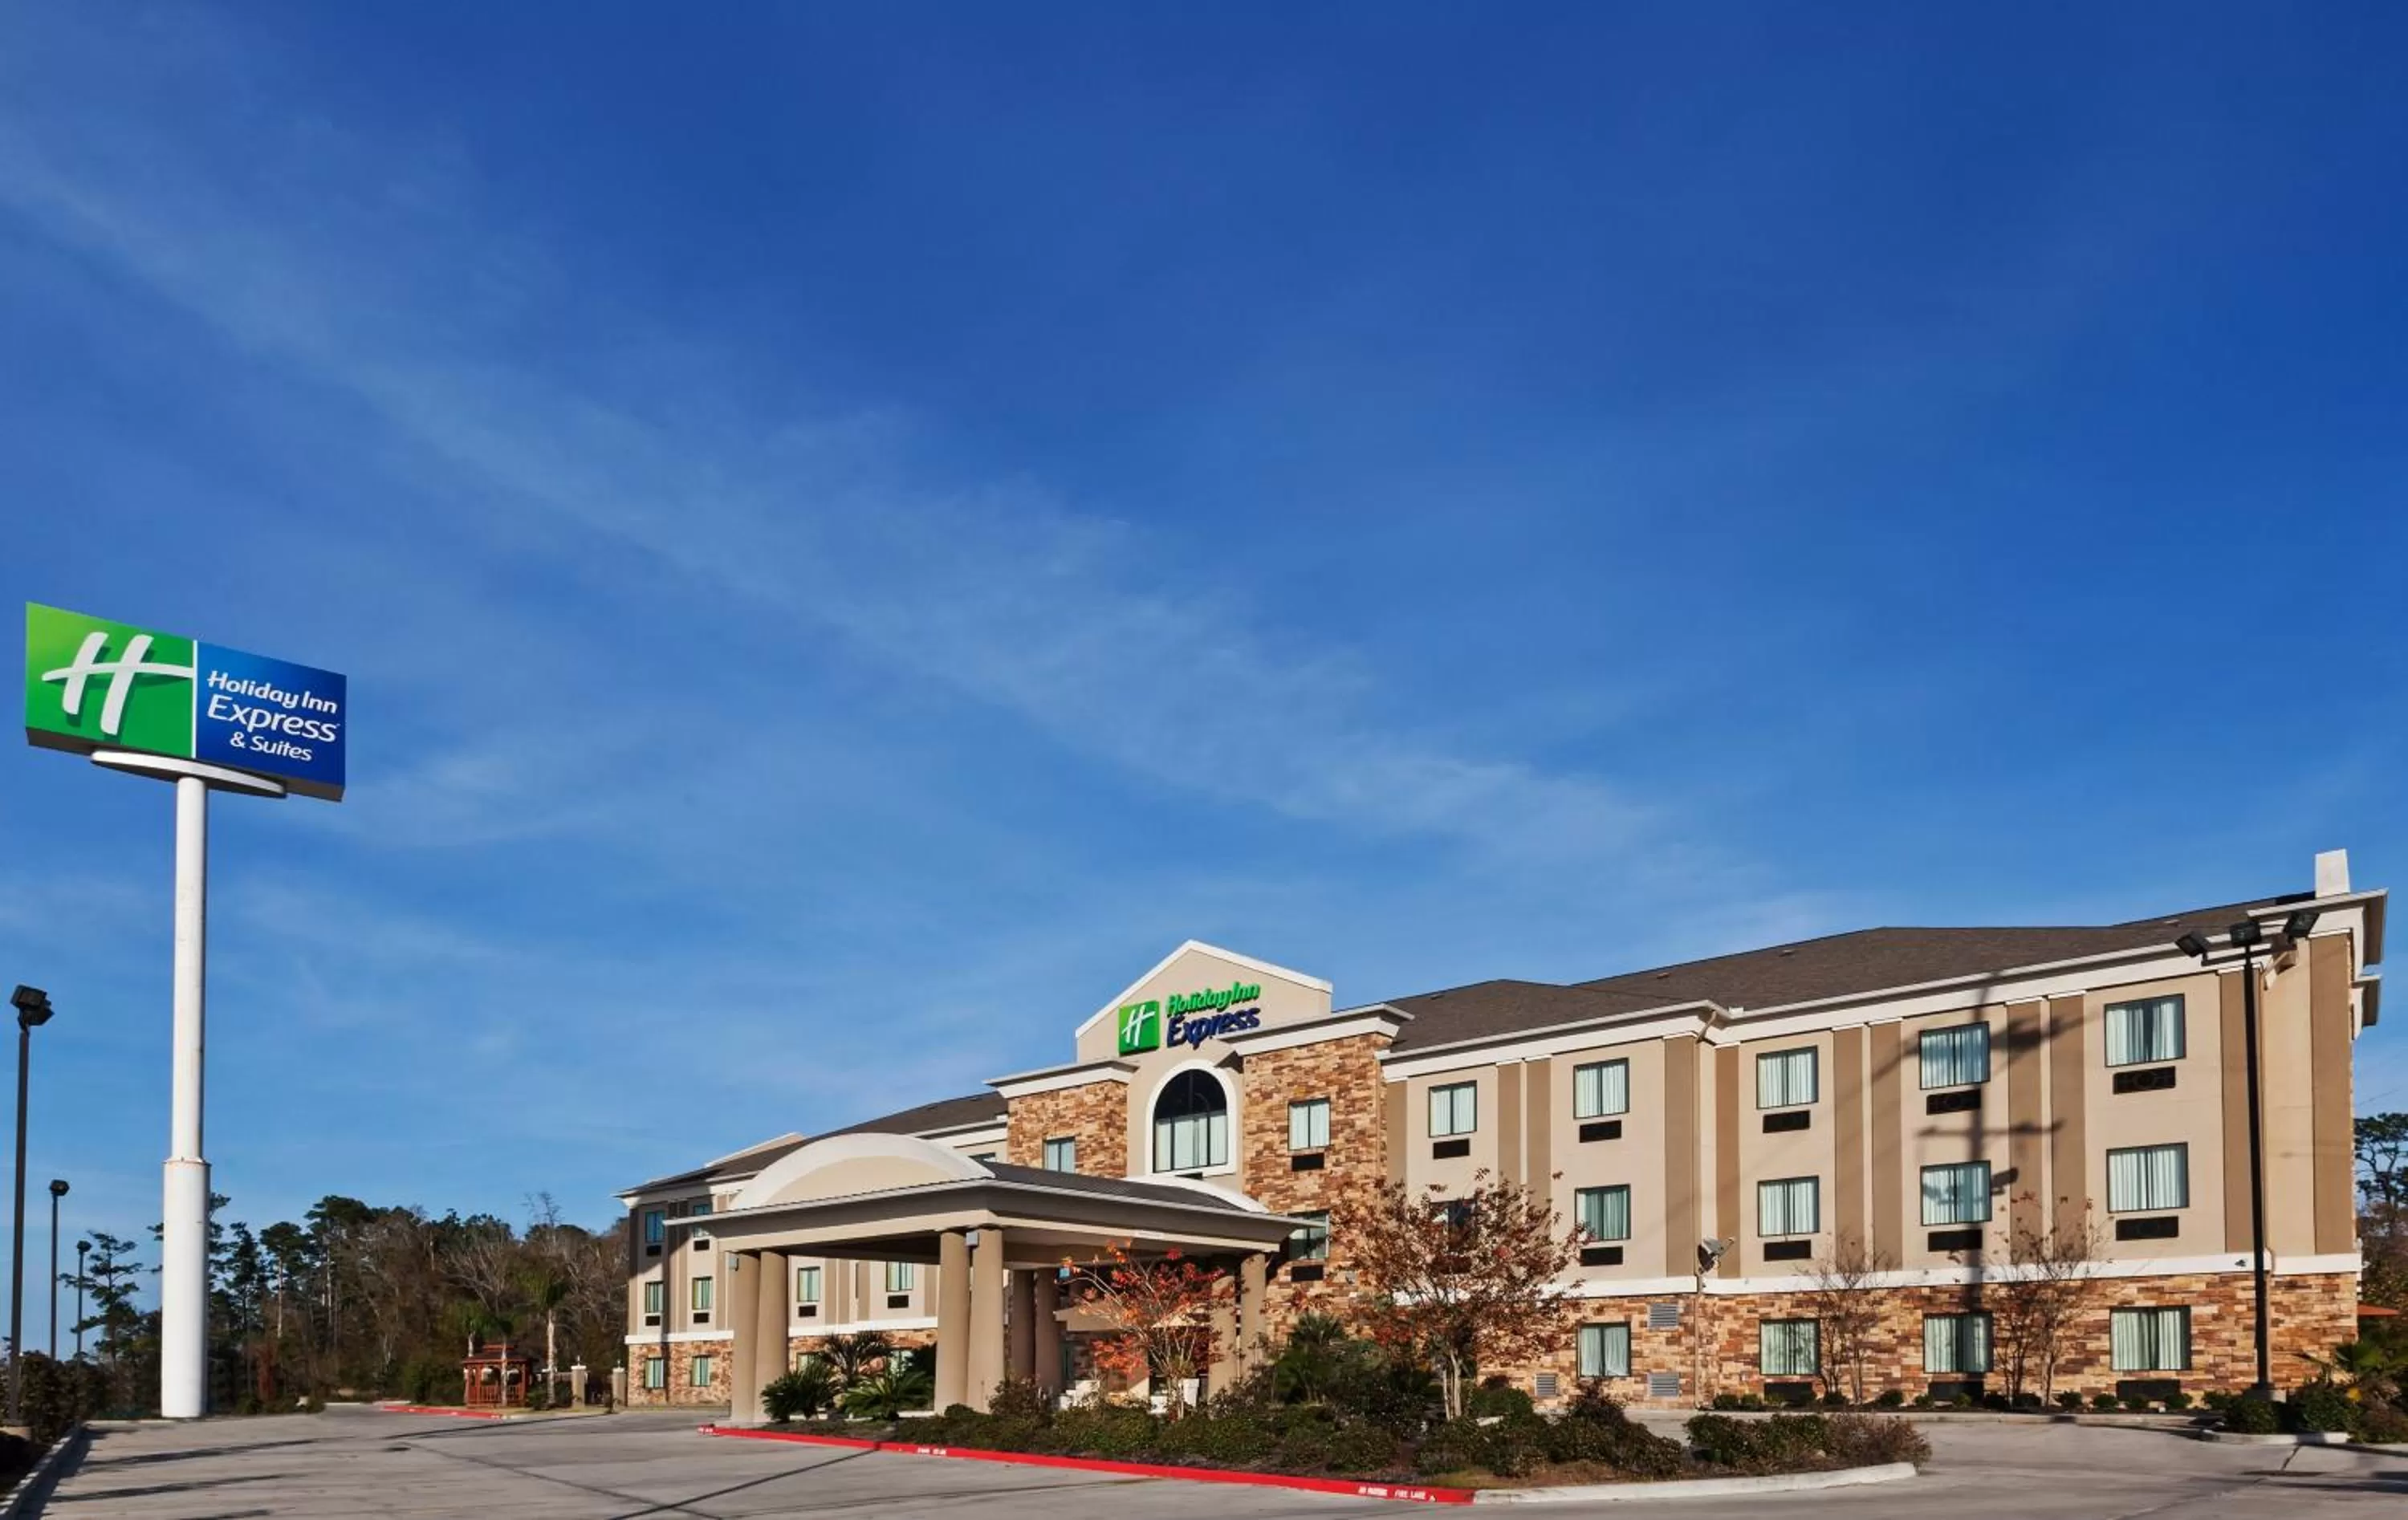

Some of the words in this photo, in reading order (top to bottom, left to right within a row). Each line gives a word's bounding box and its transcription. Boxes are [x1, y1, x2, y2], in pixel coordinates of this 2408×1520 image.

[206, 669, 299, 709] Holiday
[301, 690, 339, 714] Inn
[206, 693, 337, 743] Express
[230, 731, 246, 749] &
[250, 735, 313, 762] Suites
[1165, 988, 1234, 1018] Holiday
[1231, 981, 1261, 1005] Inn
[1166, 1006, 1261, 1051] Express
